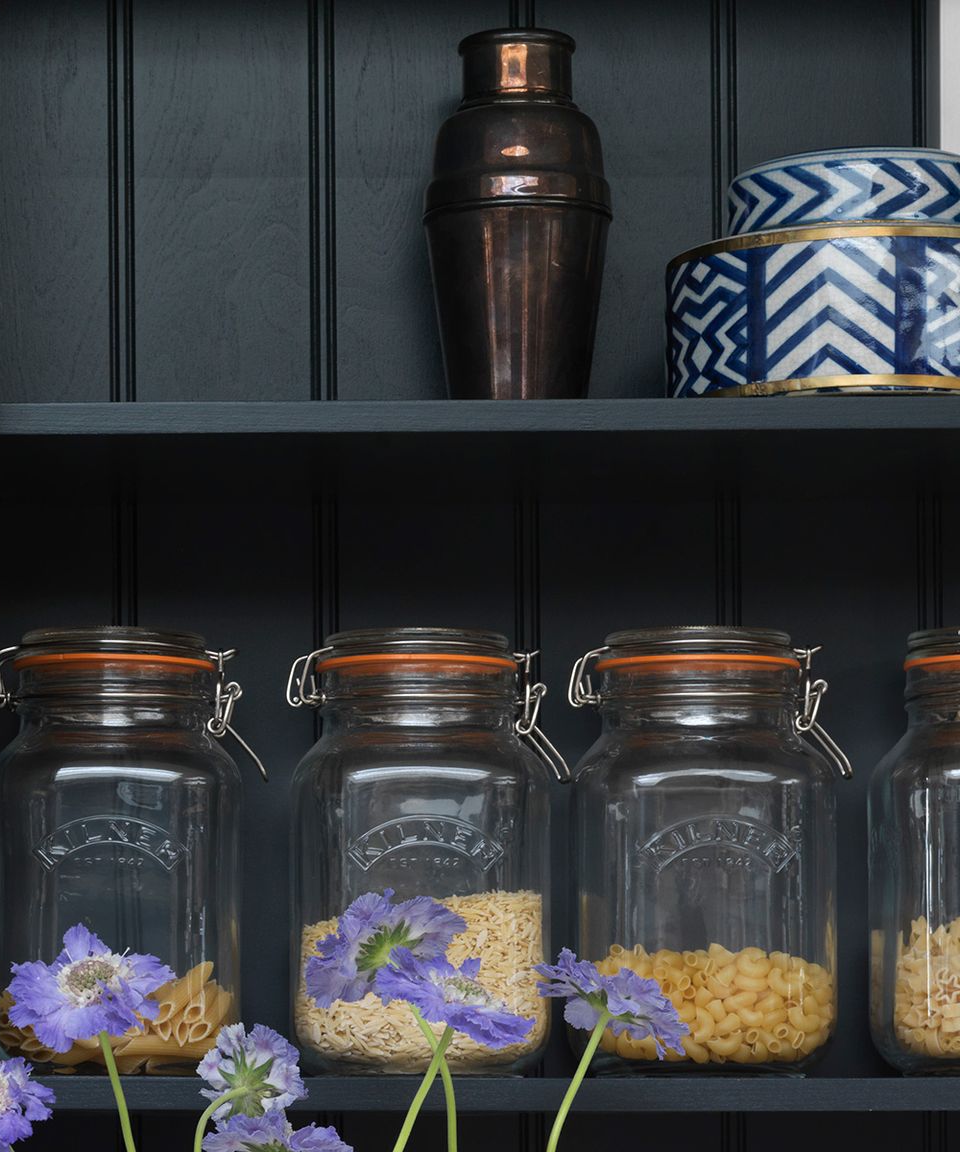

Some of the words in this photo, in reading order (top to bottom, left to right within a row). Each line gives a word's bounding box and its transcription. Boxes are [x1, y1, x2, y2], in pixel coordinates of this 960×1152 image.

[40, 821, 179, 866] KILNER
[351, 821, 497, 865] KILNER
[644, 820, 790, 865] KILNER
